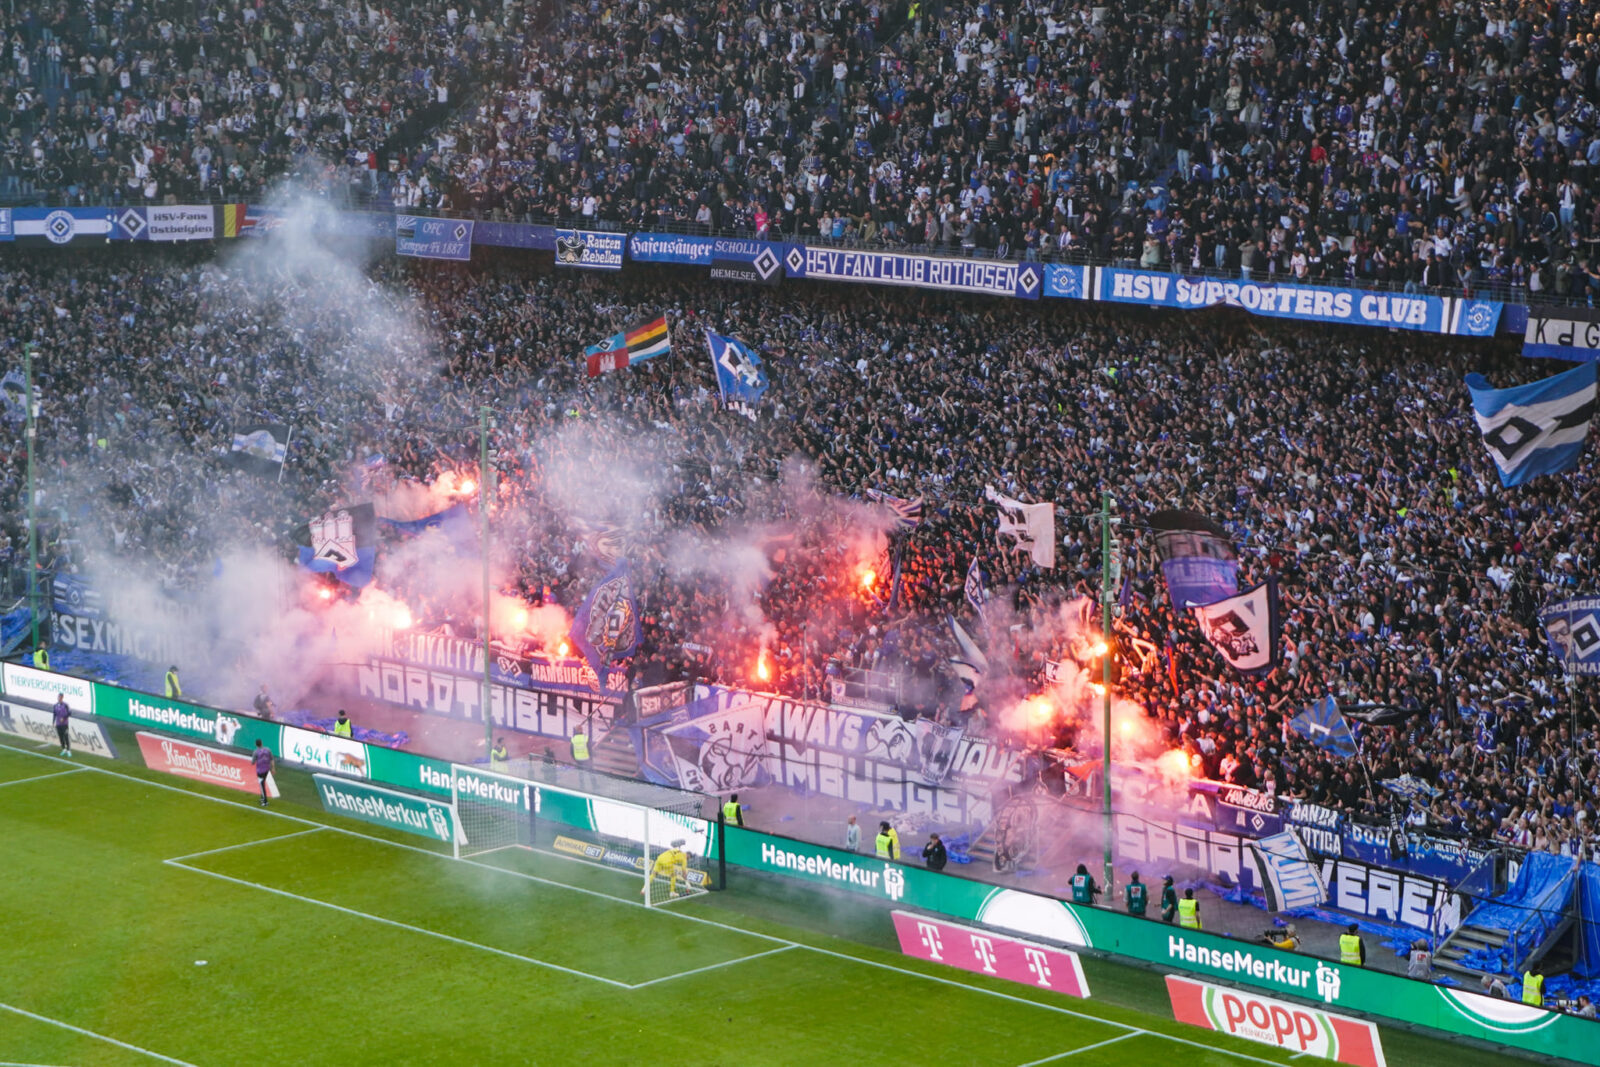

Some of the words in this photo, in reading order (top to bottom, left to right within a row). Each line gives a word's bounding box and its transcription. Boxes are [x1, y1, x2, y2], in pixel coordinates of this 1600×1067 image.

[153, 211, 208, 223] HSV-Fans
[150, 225, 213, 235] Ostbelgien
[586, 234, 621, 251] Rauten
[631, 236, 713, 261] Hafensänger
[581, 249, 622, 265] Rebellen
[710, 267, 757, 281] DIEMELSEE
[806, 249, 840, 275] HSV
[843, 252, 876, 279] FAN
[880, 254, 925, 284] CLUB
[927, 258, 1018, 294] ROTHOSEN
[1112, 272, 1169, 302] HSV
[1176, 277, 1352, 320] SUPPORTERS
[1359, 294, 1427, 325] CLUB
[409, 633, 474, 672] LOYALTY
[128, 698, 214, 734] HanseMerkur
[292, 741, 321, 763] 4,94
[419, 764, 520, 804] HanseMerkur
[322, 783, 429, 829] HanseMerkur
[1224, 789, 1275, 813] HAMBURG
[585, 846, 601, 858] BET
[604, 851, 637, 866] ADMIRAL
[686, 871, 704, 883] BET
[761, 842, 880, 888] HanseMerkur
[917, 921, 944, 961] T
[970, 934, 997, 974] T
[1024, 947, 1052, 988] T
[1168, 935, 1311, 988] HanseMerkur
[1240, 1025, 1276, 1043] FEINKOST
